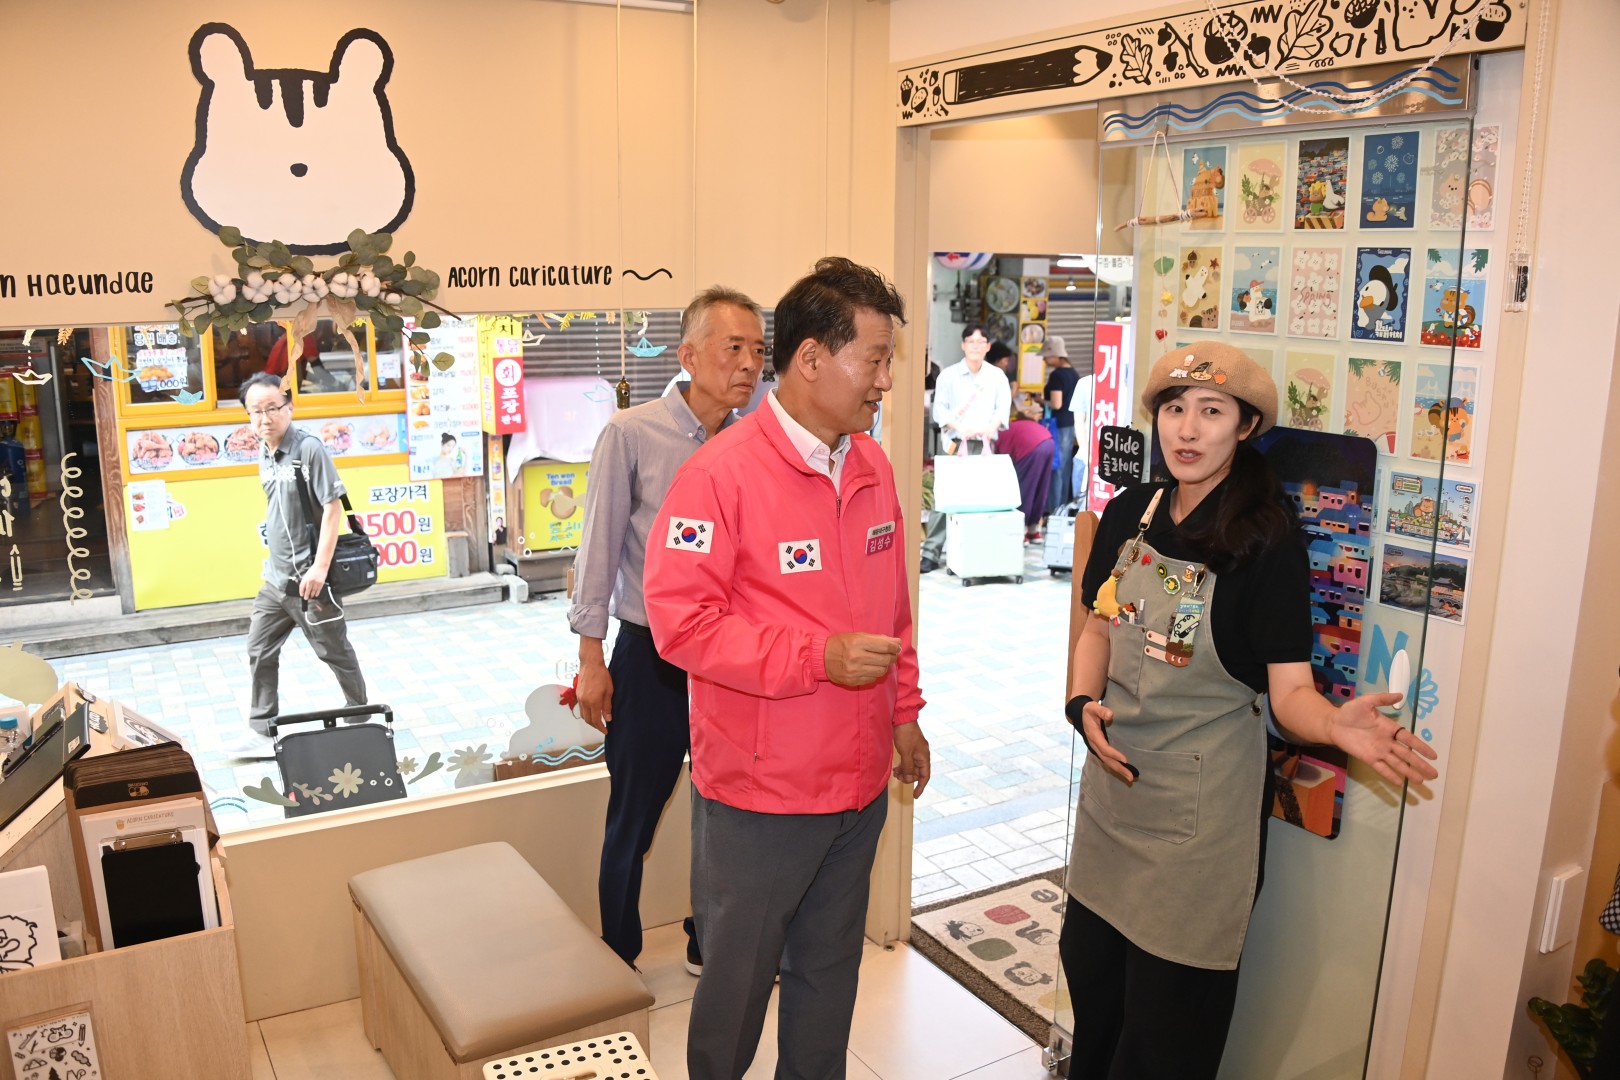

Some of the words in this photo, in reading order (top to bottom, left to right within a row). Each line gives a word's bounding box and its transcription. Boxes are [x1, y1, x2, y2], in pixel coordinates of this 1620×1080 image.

[27, 271, 154, 297] Haeundae
[447, 266, 500, 288] Acorn
[501, 387, 520, 413] 포장
[1104, 432, 1140, 456] Slide
[1102, 455, 1140, 479] 슬라이드
[371, 485, 427, 503] 포장가격
[870, 535, 891, 553] 김성수
